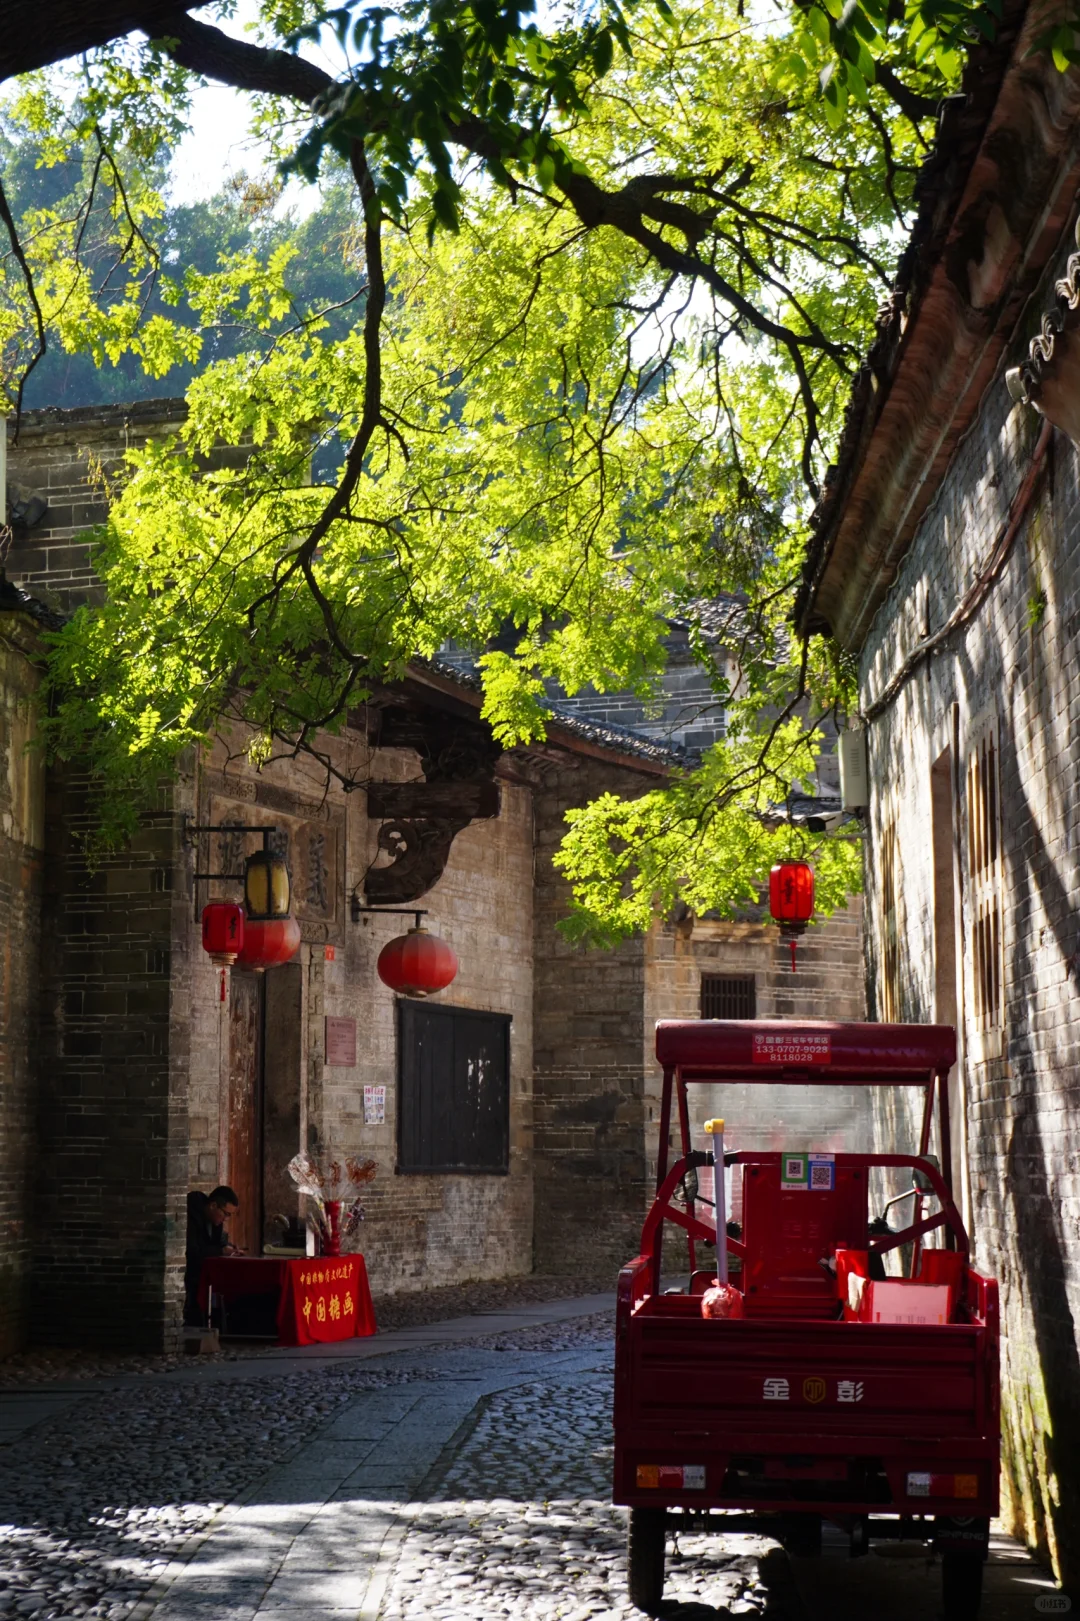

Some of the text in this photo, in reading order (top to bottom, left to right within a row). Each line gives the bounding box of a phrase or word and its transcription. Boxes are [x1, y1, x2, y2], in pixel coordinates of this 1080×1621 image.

[756, 1045, 829, 1054] 133-0707-9028
[769, 1053, 813, 1062] 8118028
[302, 1290, 354, 1326] 中国糖画
[762, 1378, 864, 1403] 金 彭
